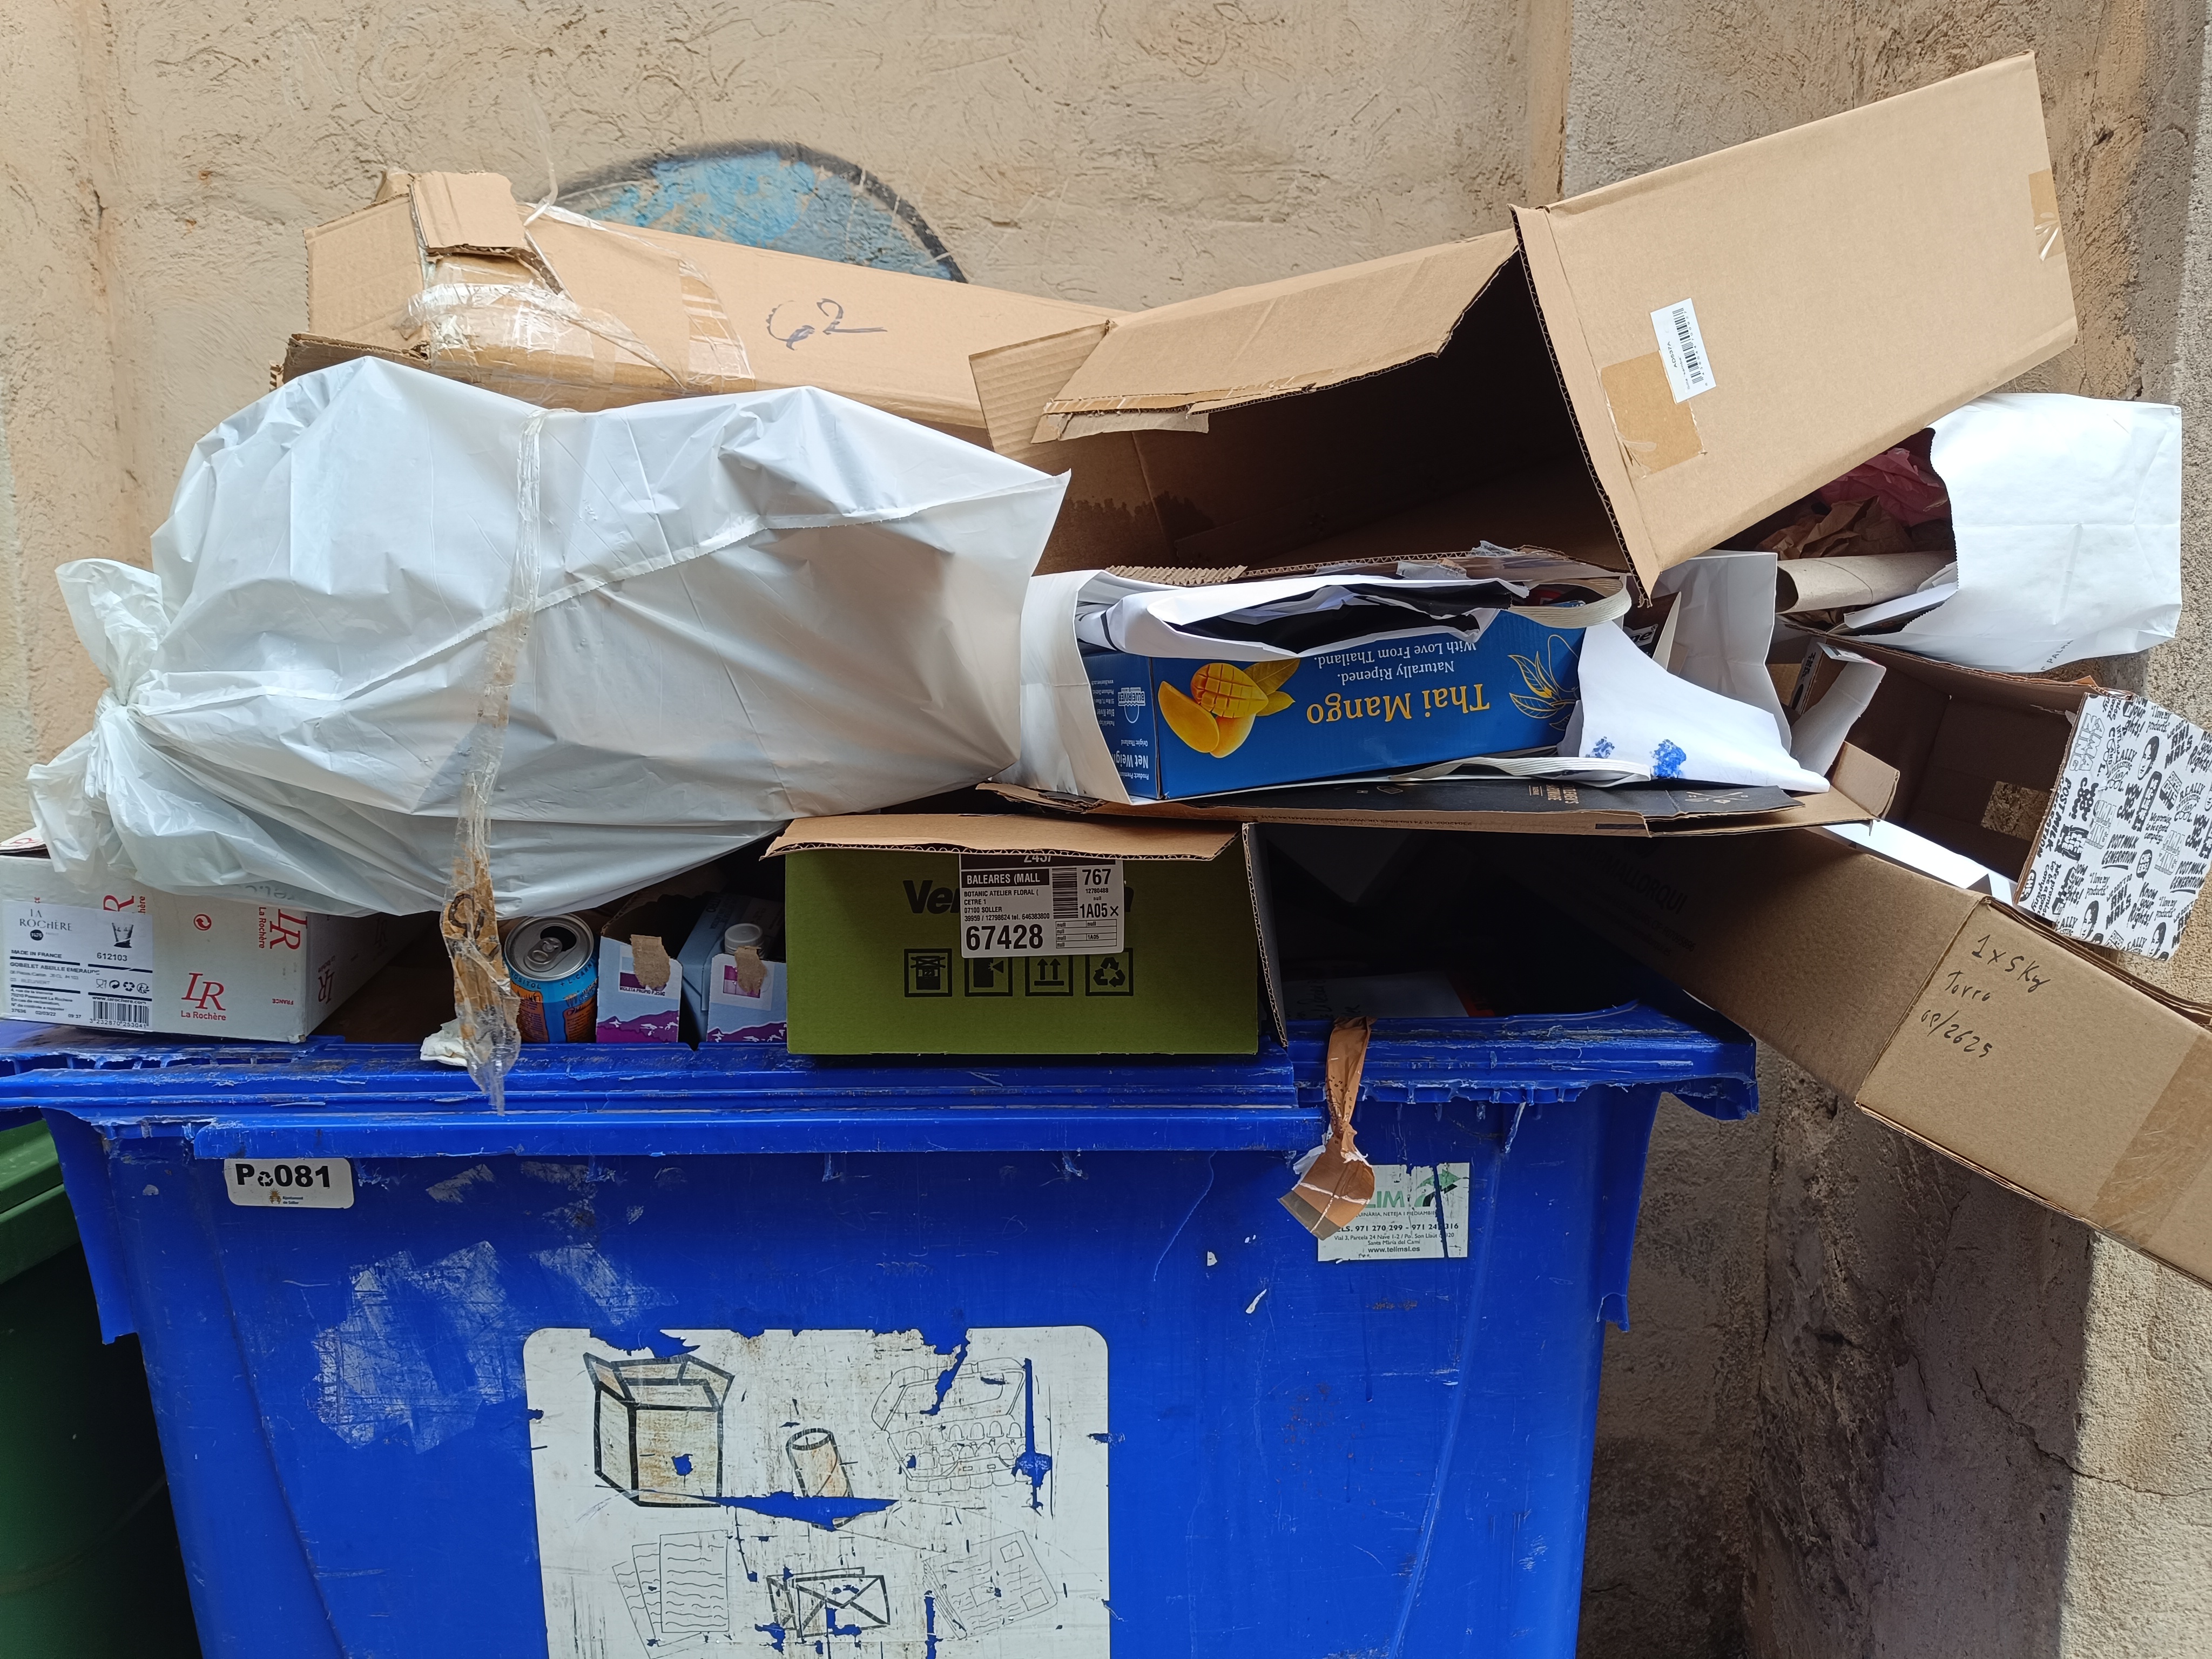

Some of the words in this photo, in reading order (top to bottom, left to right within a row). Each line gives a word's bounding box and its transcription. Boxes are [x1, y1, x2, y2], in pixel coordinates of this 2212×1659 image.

[1667, 341, 1678, 368] AD537A
[1378, 647, 1410, 658] From
[1414, 643, 1443, 655] Love
[1446, 641, 1476, 652] With
[1314, 651, 1375, 669] Thailand.
[1338, 667, 1392, 686] Ripened.
[1396, 661, 1454, 678] Naturally
[1118, 692, 1132, 702] RIVER
[1421, 684, 1490, 718] Thai
[1306, 693, 1412, 724] Mango
[2069, 712, 2098, 772] ZING
[1112, 751, 1134, 768] Weig
[1135, 755, 1149, 769] Net
[2058, 777, 2072, 814] POST
[2069, 777, 2087, 819] COW!
[2179, 783, 2206, 802] REALLY
[2046, 811, 2062, 852] MILK
[2107, 834, 2124, 849] POST
[2122, 835, 2140, 849] MILK
[2163, 830, 2186, 855] AMA
[2101, 850, 2137, 865] GENERATION
[2154, 848, 2179, 875] ZING
[2053, 864, 2061, 879] We
[2175, 861, 2190, 875] POST
[2189, 862, 2207, 875] MILK
[967, 874, 1011, 885] BALEARES
[1014, 873, 1041, 885] (MALL
[1082, 868, 1111, 886] 767
[2170, 876, 2205, 889] GENERATION
[2139, 881, 2159, 900] Know
[30, 908, 42, 918] LA
[259, 907, 267, 916] La
[1080, 903, 1108, 919] 1A05
[19, 918, 73, 932] ROCHÈRE
[258, 918, 267, 949] Rochère
[269, 908, 308, 950] LR
[966, 923, 1043, 951] 67428
[97, 952, 127, 962] 612103
[181, 973, 226, 1010] LR
[181, 1010, 191, 1019] La
[193, 1011, 226, 1021] Rochère
[123, 1020, 146, 1029] 253041
